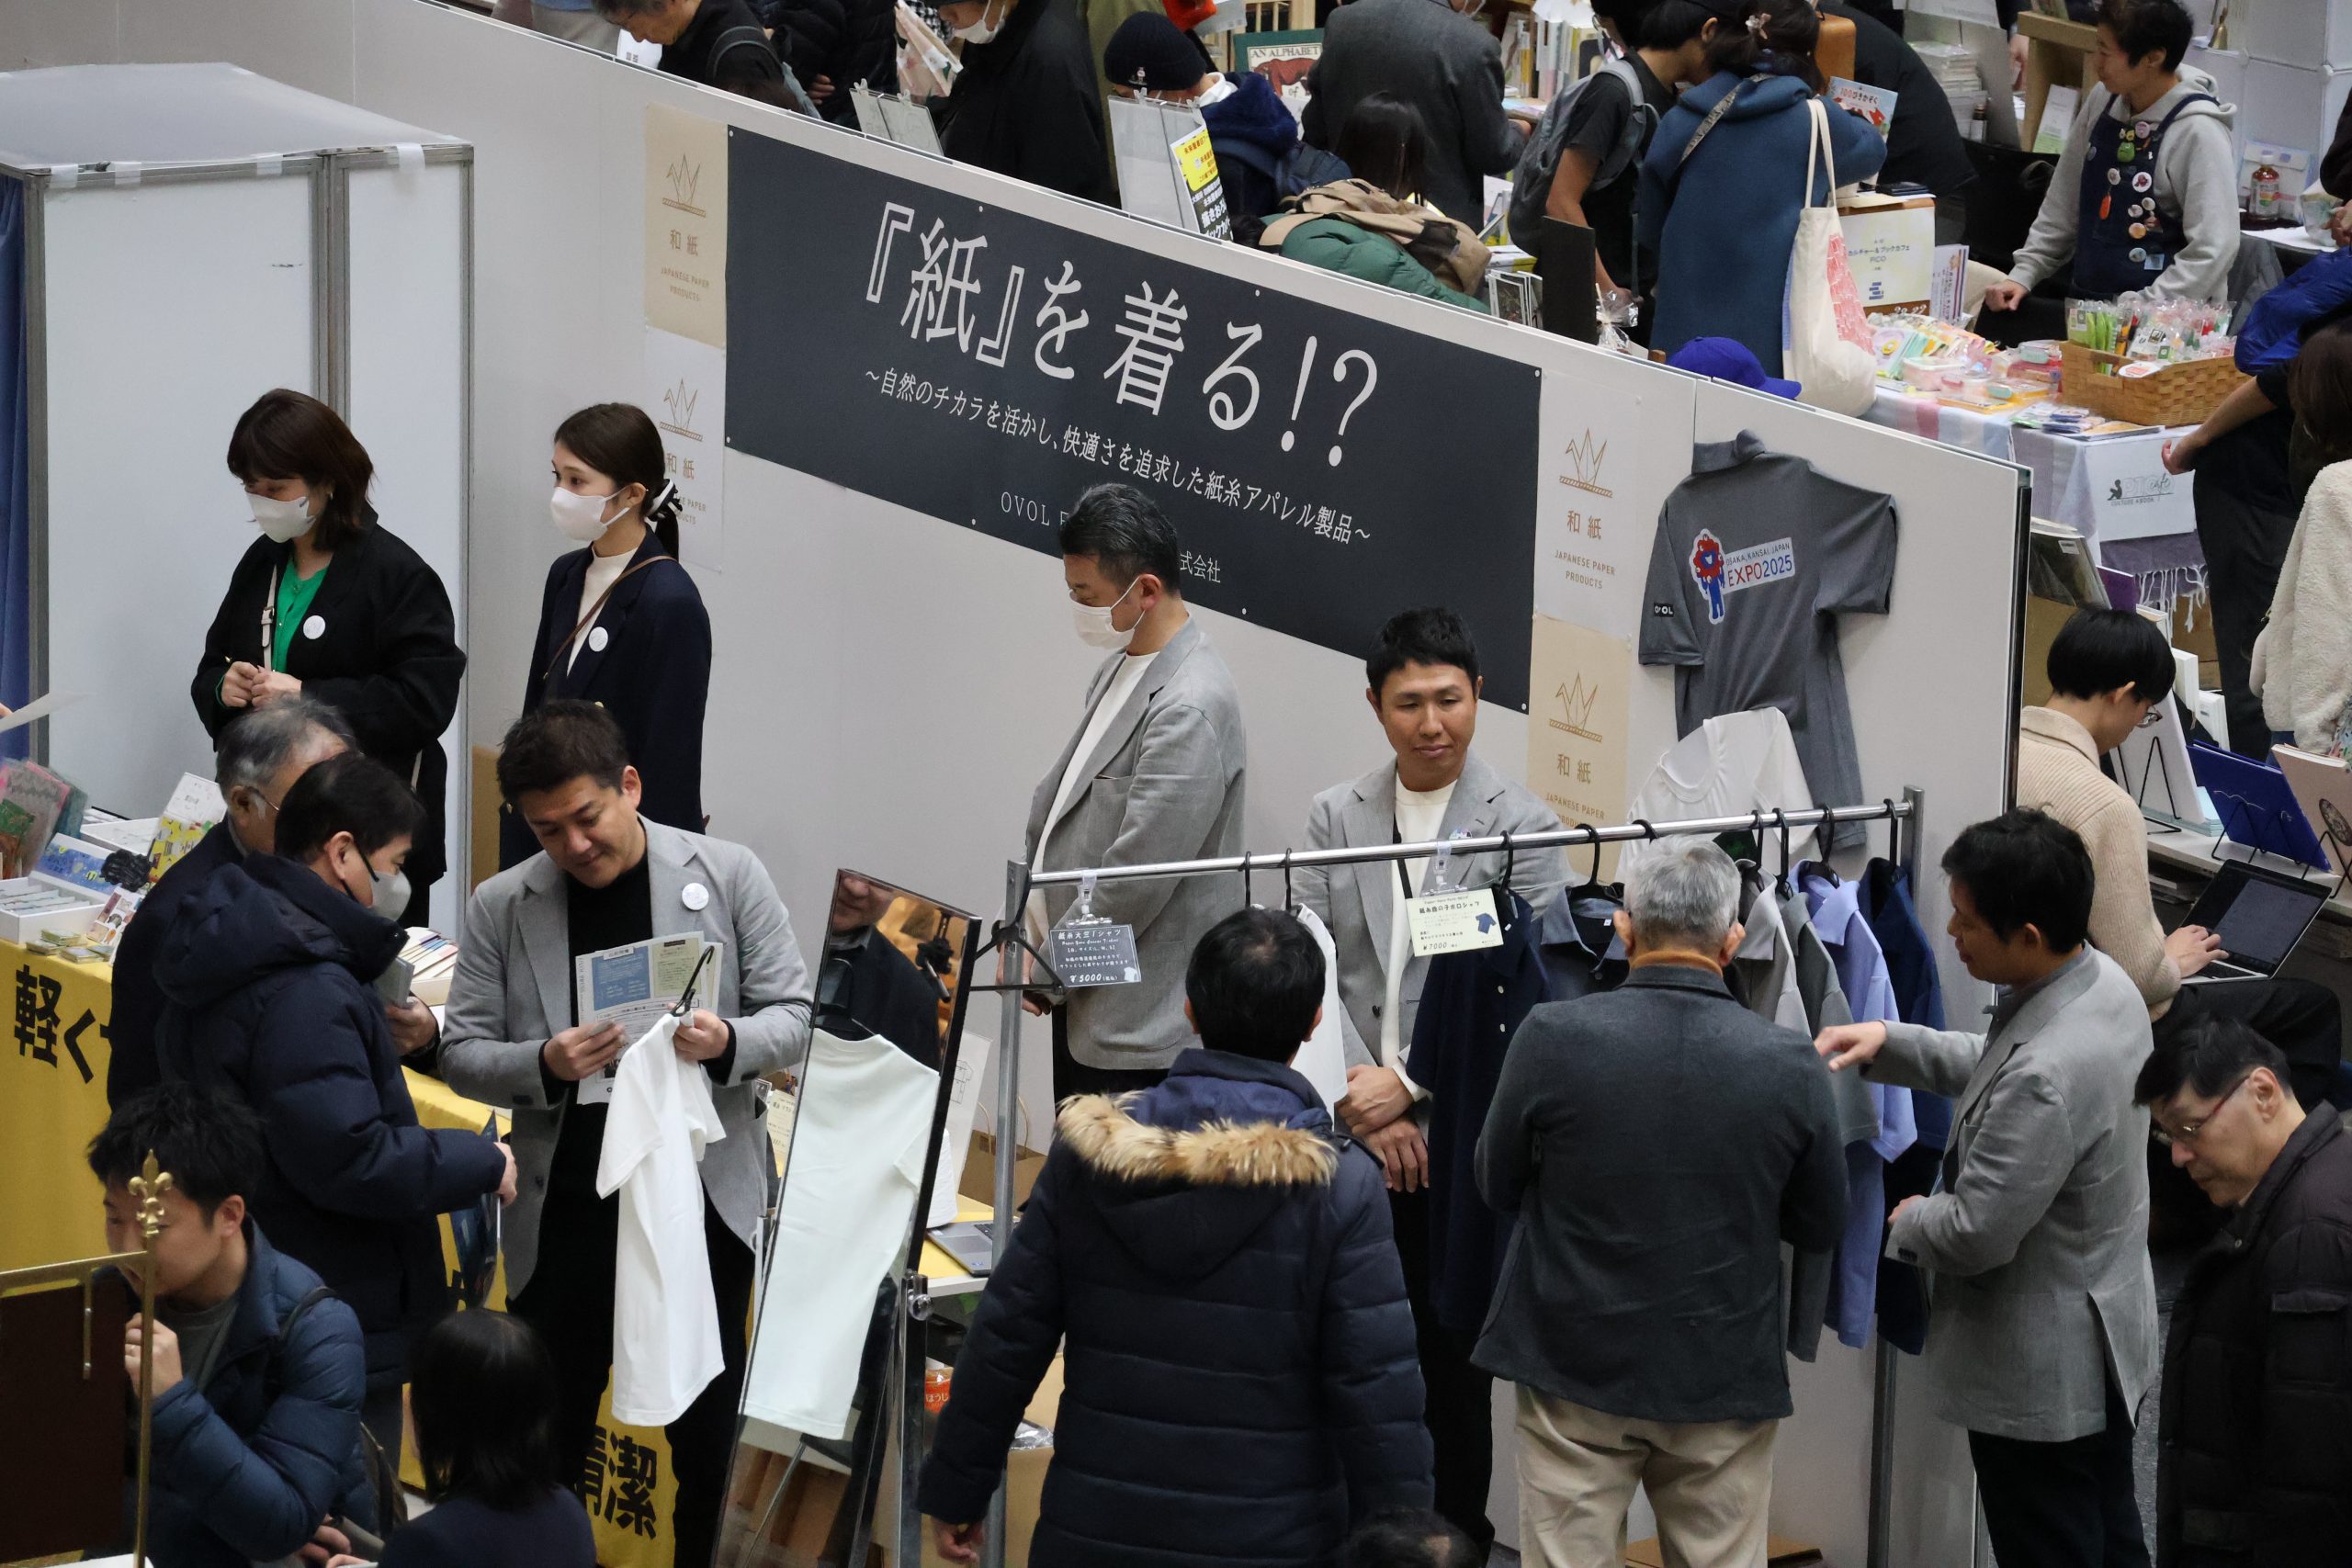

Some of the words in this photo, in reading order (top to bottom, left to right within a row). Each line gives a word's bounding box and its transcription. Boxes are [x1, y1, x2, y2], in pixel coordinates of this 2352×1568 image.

[1250, 49, 1268, 59] AN
[1268, 46, 1319, 58] ALPHABET
[670, 229, 699, 256] 和紙
[666, 452, 695, 480] 和紙
[1000, 491, 1051, 527] OVOL
[1566, 510, 1603, 541] 和紙
[1555, 549, 1591, 570] JAPANESE
[1592, 558, 1616, 576] PAPER
[1771, 542, 1791, 555] JAPAN
[1566, 570, 1603, 590] PRODUCTS
[1727, 554, 1793, 588] EXPO2025
[1556, 752, 1592, 785] 和紙
[1545, 792, 1580, 813] JAPANESE
[1581, 804, 1605, 820] PAPER
[14, 963, 111, 1084] 軽く
